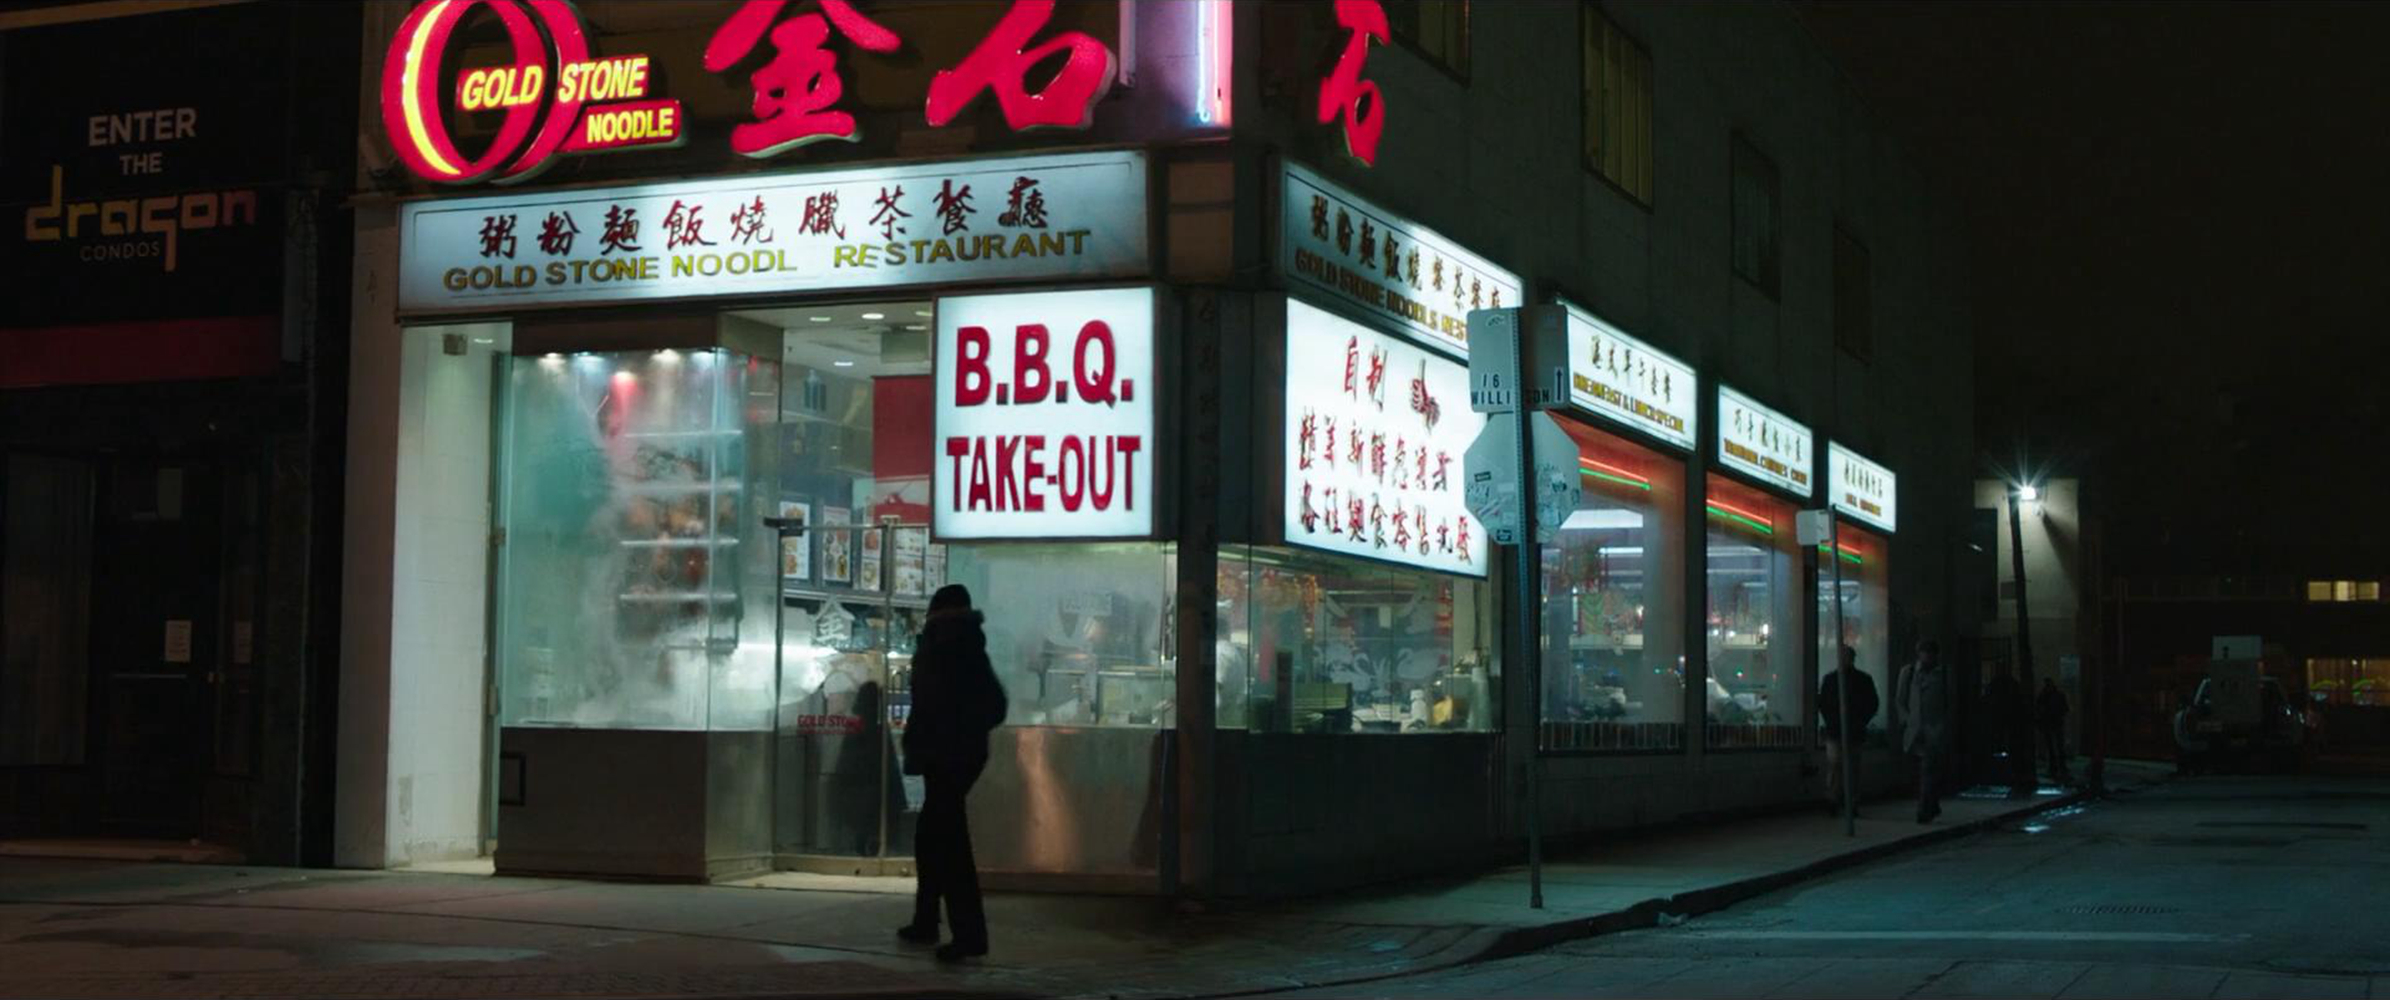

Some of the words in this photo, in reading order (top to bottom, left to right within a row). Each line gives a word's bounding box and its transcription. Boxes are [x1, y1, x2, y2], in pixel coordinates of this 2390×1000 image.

[462, 65, 543, 110] GOLD
[558, 57, 648, 103] STONE
[88, 107, 199, 147] ENTER
[587, 107, 674, 143] NOODLE
[120, 152, 164, 175] THE
[25, 163, 258, 273] dragon
[80, 241, 160, 262] CONDOS
[443, 264, 536, 291] GOLD
[545, 256, 659, 286] STONE
[834, 229, 1091, 269] RESTAURANT
[955, 320, 1133, 408] B.B.Q.
[946, 435, 1141, 512] TAKE-OUT
